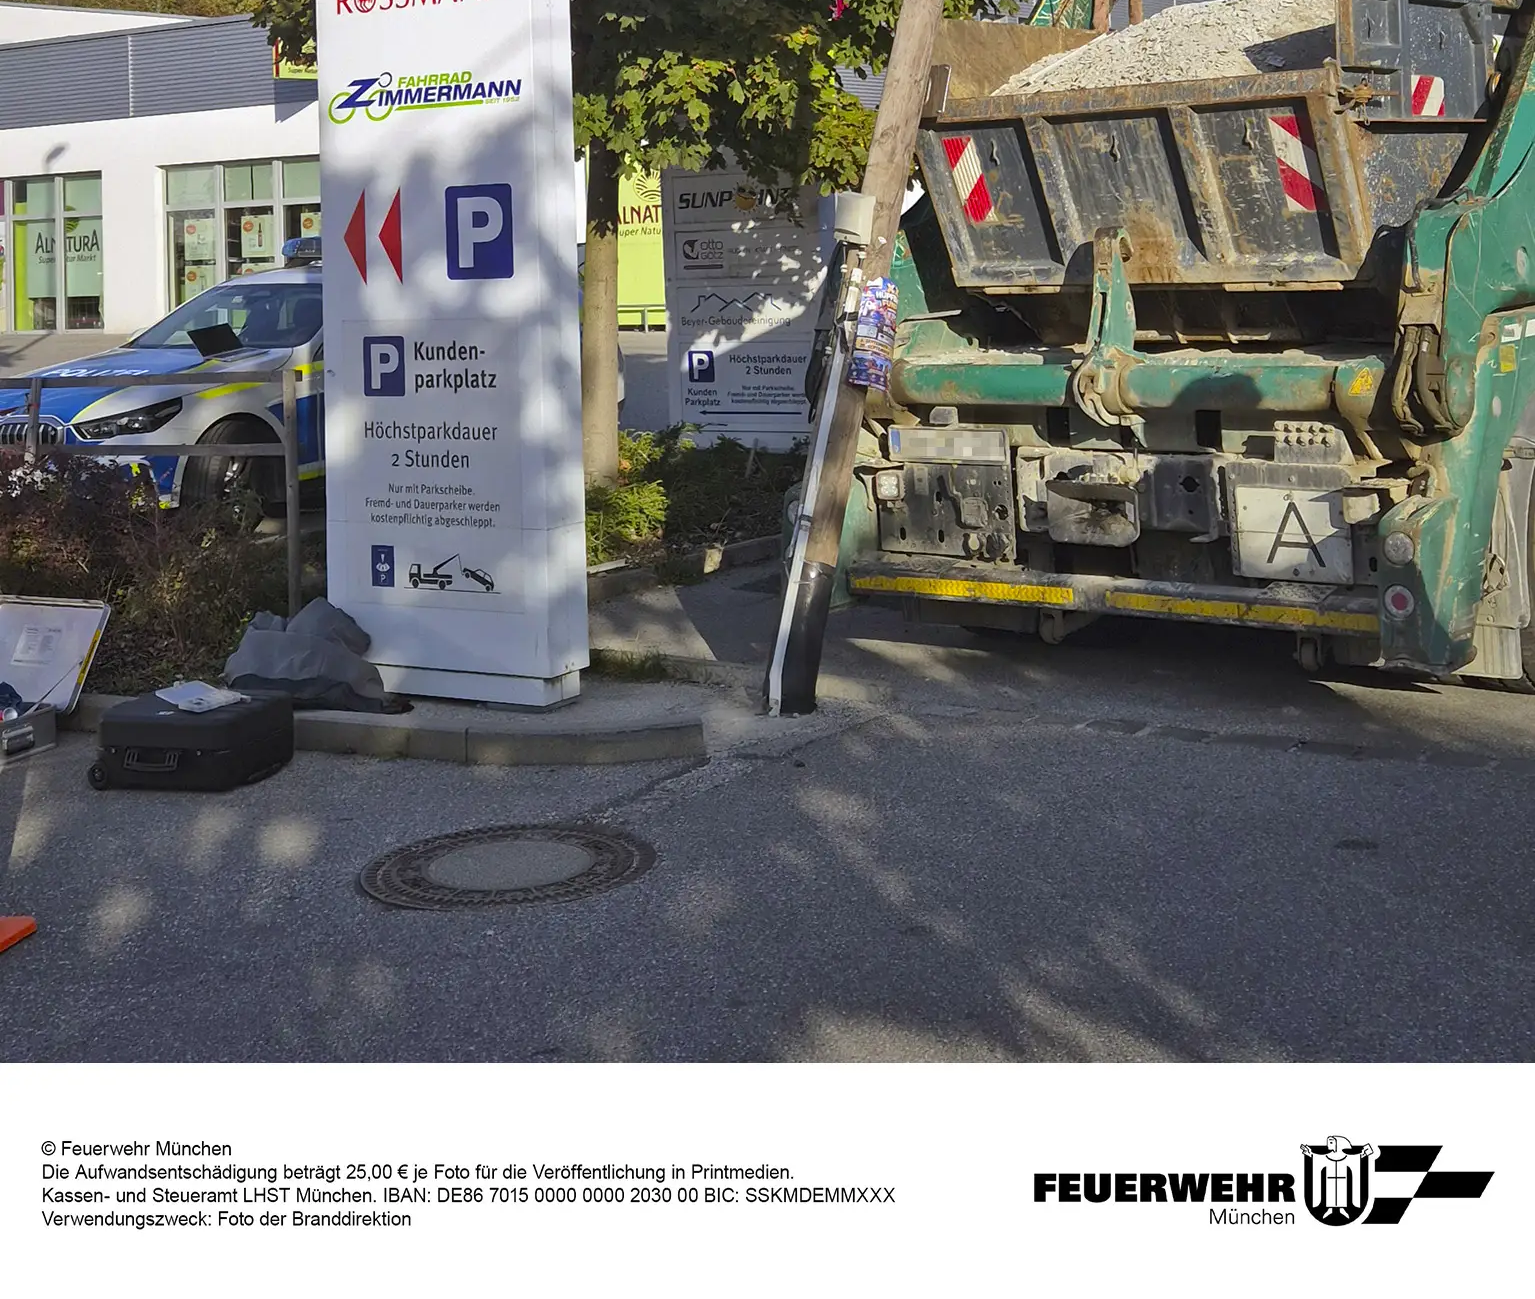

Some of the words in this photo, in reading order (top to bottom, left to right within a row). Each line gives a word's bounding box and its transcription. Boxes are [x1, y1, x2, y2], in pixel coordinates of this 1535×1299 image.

[397, 71, 473, 89] FAHRRAD
[335, 77, 522, 110] ZIMMERMANN
[457, 197, 504, 269] P
[619, 229, 639, 238] uper
[700, 239, 724, 251] otto
[414, 340, 486, 361] Kunden-
[729, 354, 808, 365] Höchstparkdauer
[370, 344, 400, 390] P
[691, 353, 710, 380] P
[745, 366, 752, 375] 2
[753, 365, 792, 375] Stunden
[415, 368, 497, 394] parkplatz
[687, 387, 718, 397] Kunden
[685, 397, 721, 407] Parkplatz
[364, 420, 498, 444] Höchstparkdauer
[391, 453, 400, 467] 2
[404, 449, 470, 468] Stunden
[388, 483, 404, 495] Nur
[405, 483, 419, 495] mit
[420, 484, 476, 497] Parkscheibe.
[365, 497, 394, 509] Fremd-
[395, 498, 412, 509] und
[413, 499, 467, 513] Dauerparker
[468, 501, 501, 512] werden
[370, 512, 433, 527] kostenpflichtig
[434, 515, 496, 529] abgeschleppt.
[1266, 501, 1327, 569] A
